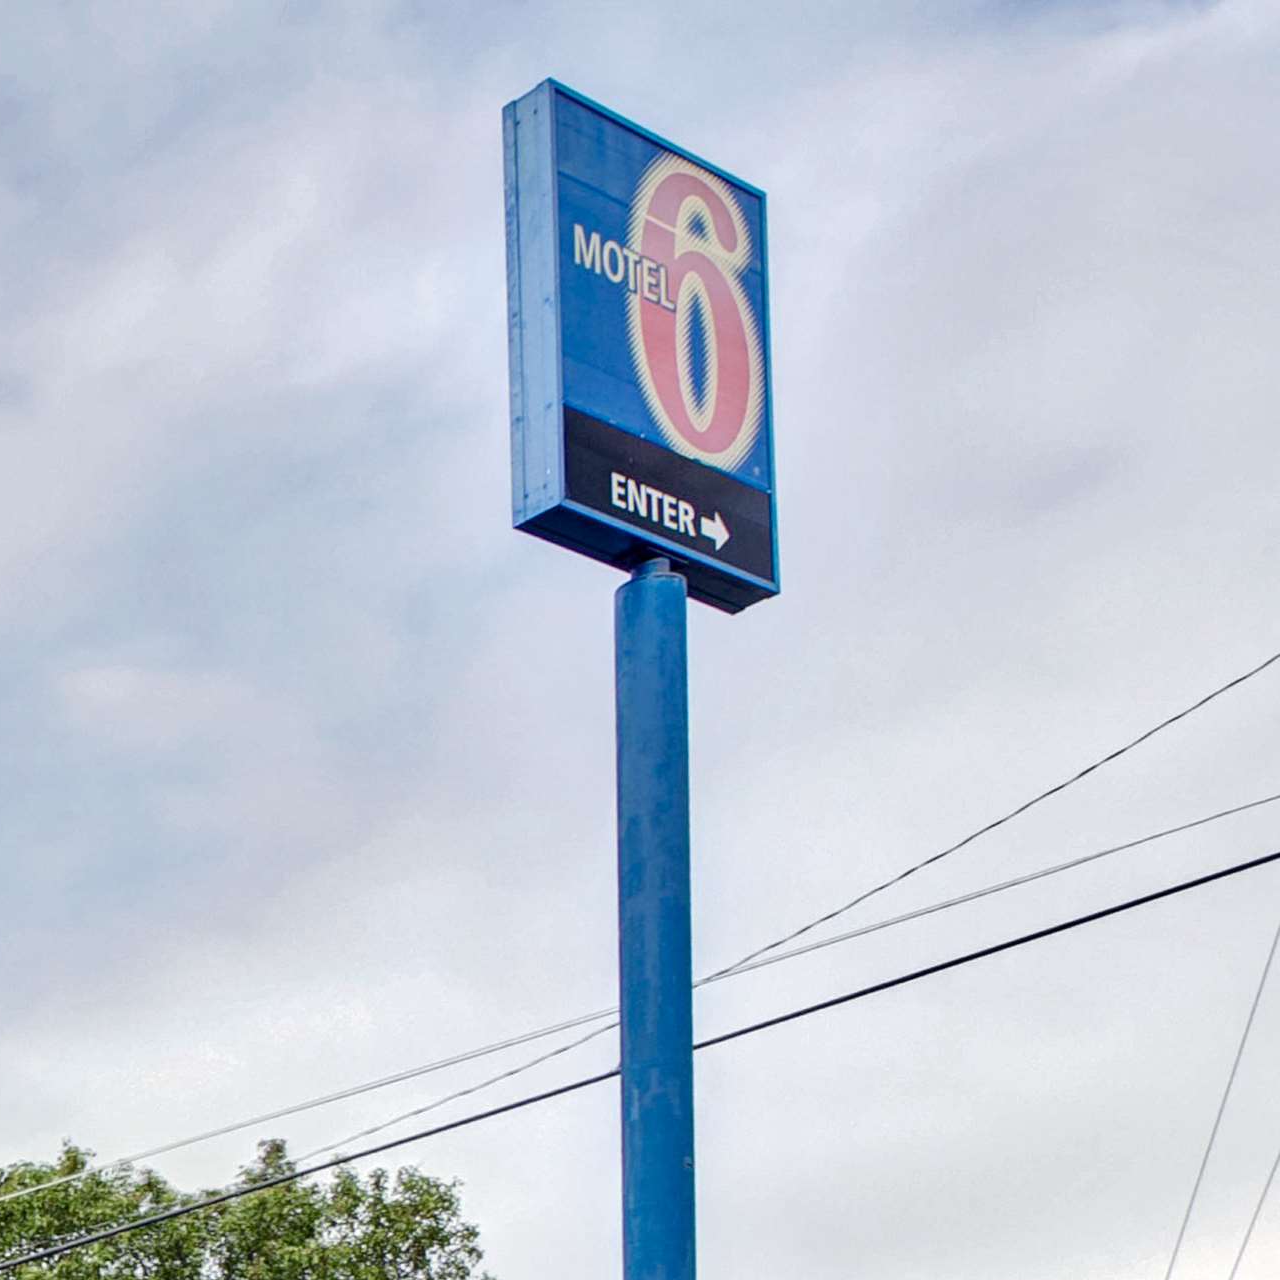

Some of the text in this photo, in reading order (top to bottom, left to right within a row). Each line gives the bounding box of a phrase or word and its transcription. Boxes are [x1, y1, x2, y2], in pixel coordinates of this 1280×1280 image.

[573, 156, 762, 468] MOTEL 6
[611, 471, 697, 537] ENTER
